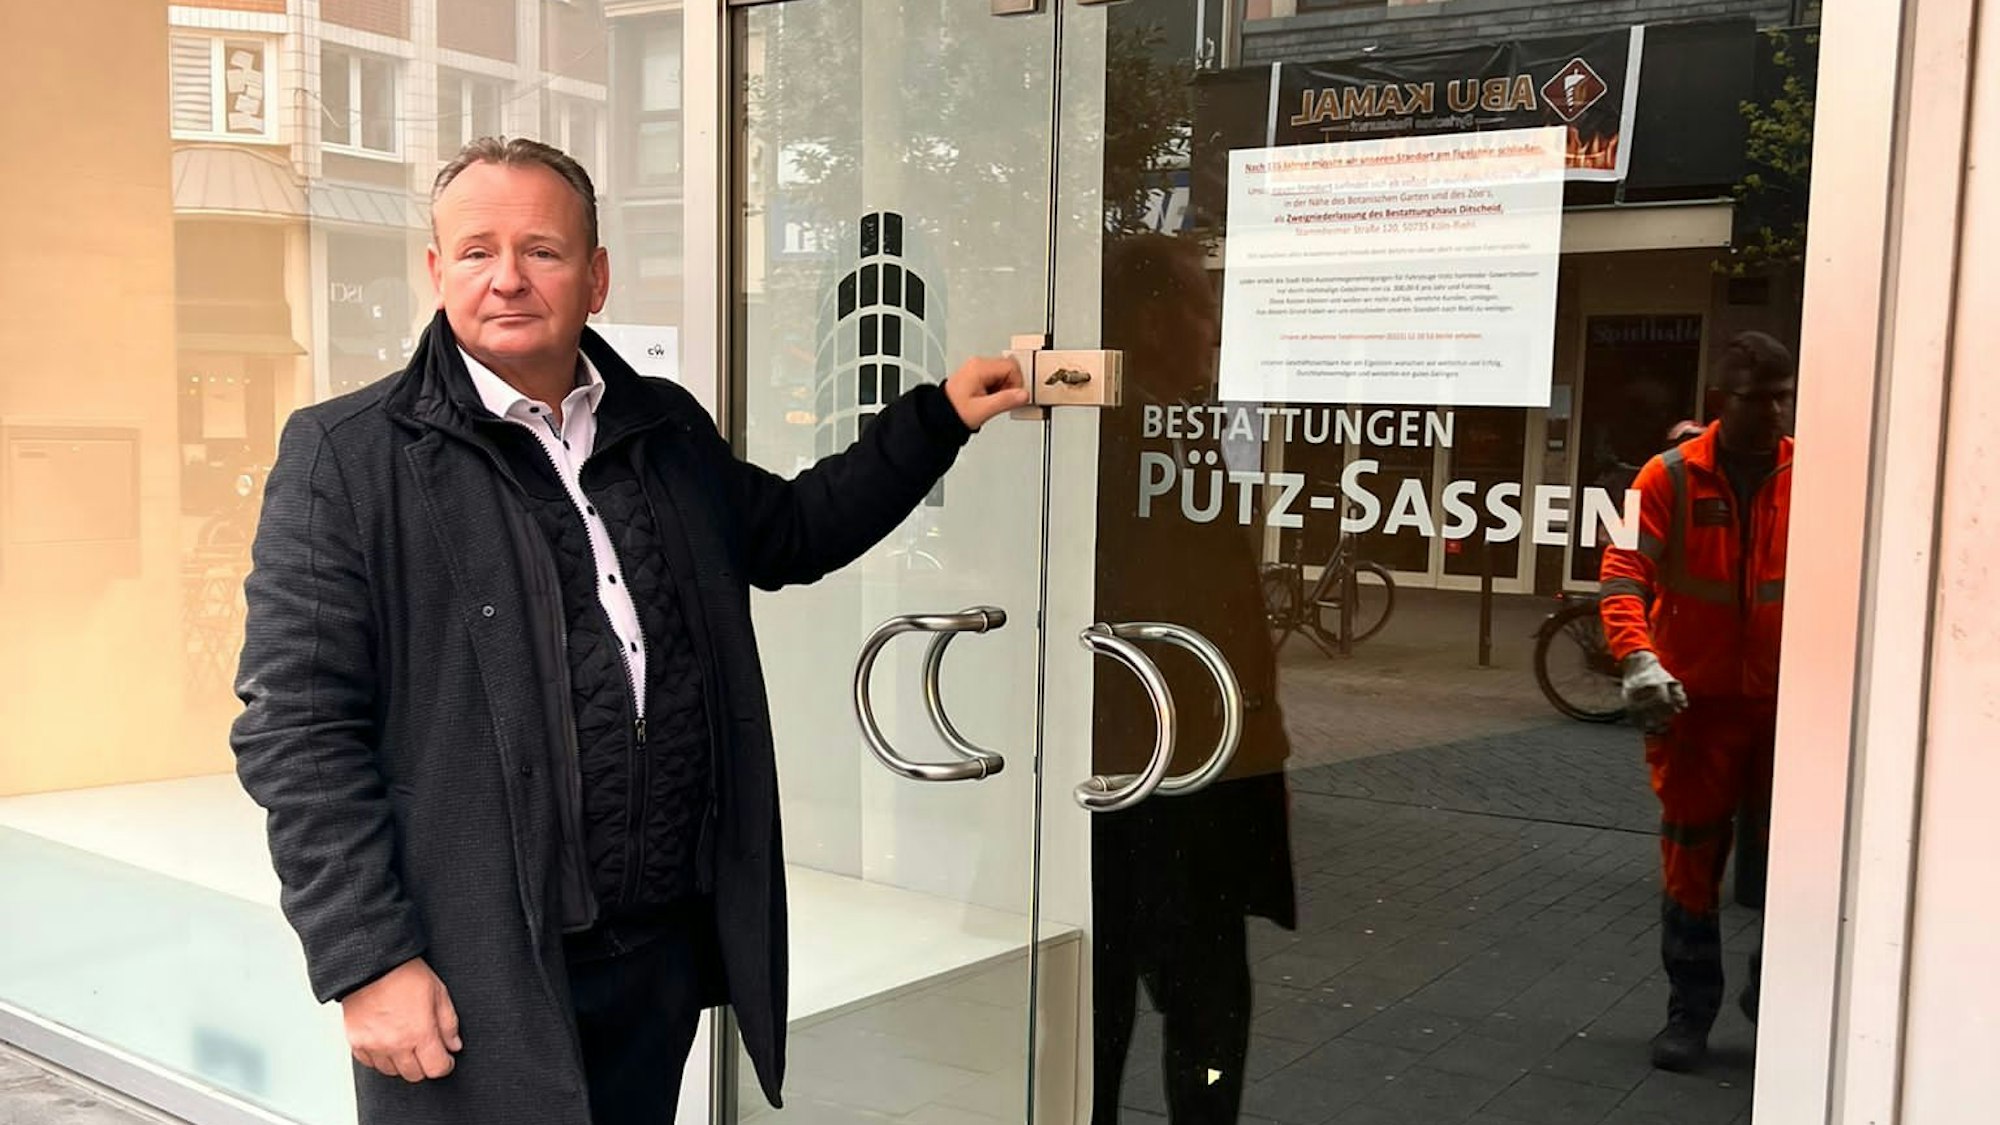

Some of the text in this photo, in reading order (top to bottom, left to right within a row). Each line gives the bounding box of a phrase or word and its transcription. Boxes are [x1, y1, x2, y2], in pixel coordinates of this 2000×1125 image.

[1244, 161, 1265, 173] Nach
[1282, 158, 1310, 170] Jahren
[1311, 156, 1343, 168] müssen
[1359, 152, 1394, 165] unseren
[1396, 149, 1435, 163] Standort
[1283, 198, 1292, 209] in
[1292, 197, 1306, 209] der
[1307, 196, 1329, 208] Nähe
[1330, 195, 1346, 207] des
[1346, 192, 1398, 206] Botanischen
[1399, 190, 1430, 203] Garten
[1430, 189, 1448, 201] und
[1448, 188, 1466, 200] des
[1295, 180, 1332, 194] Standort
[1273, 202, 1504, 225] als Zweigniederlassung des Bestattungshaus Ditscheid,
[1352, 222, 1380, 235] Straße
[1400, 220, 1429, 232] 50735
[1143, 404, 1455, 448] BESTATTUNGEN
[1137, 450, 1642, 550] PÜTZ-SASSEN
